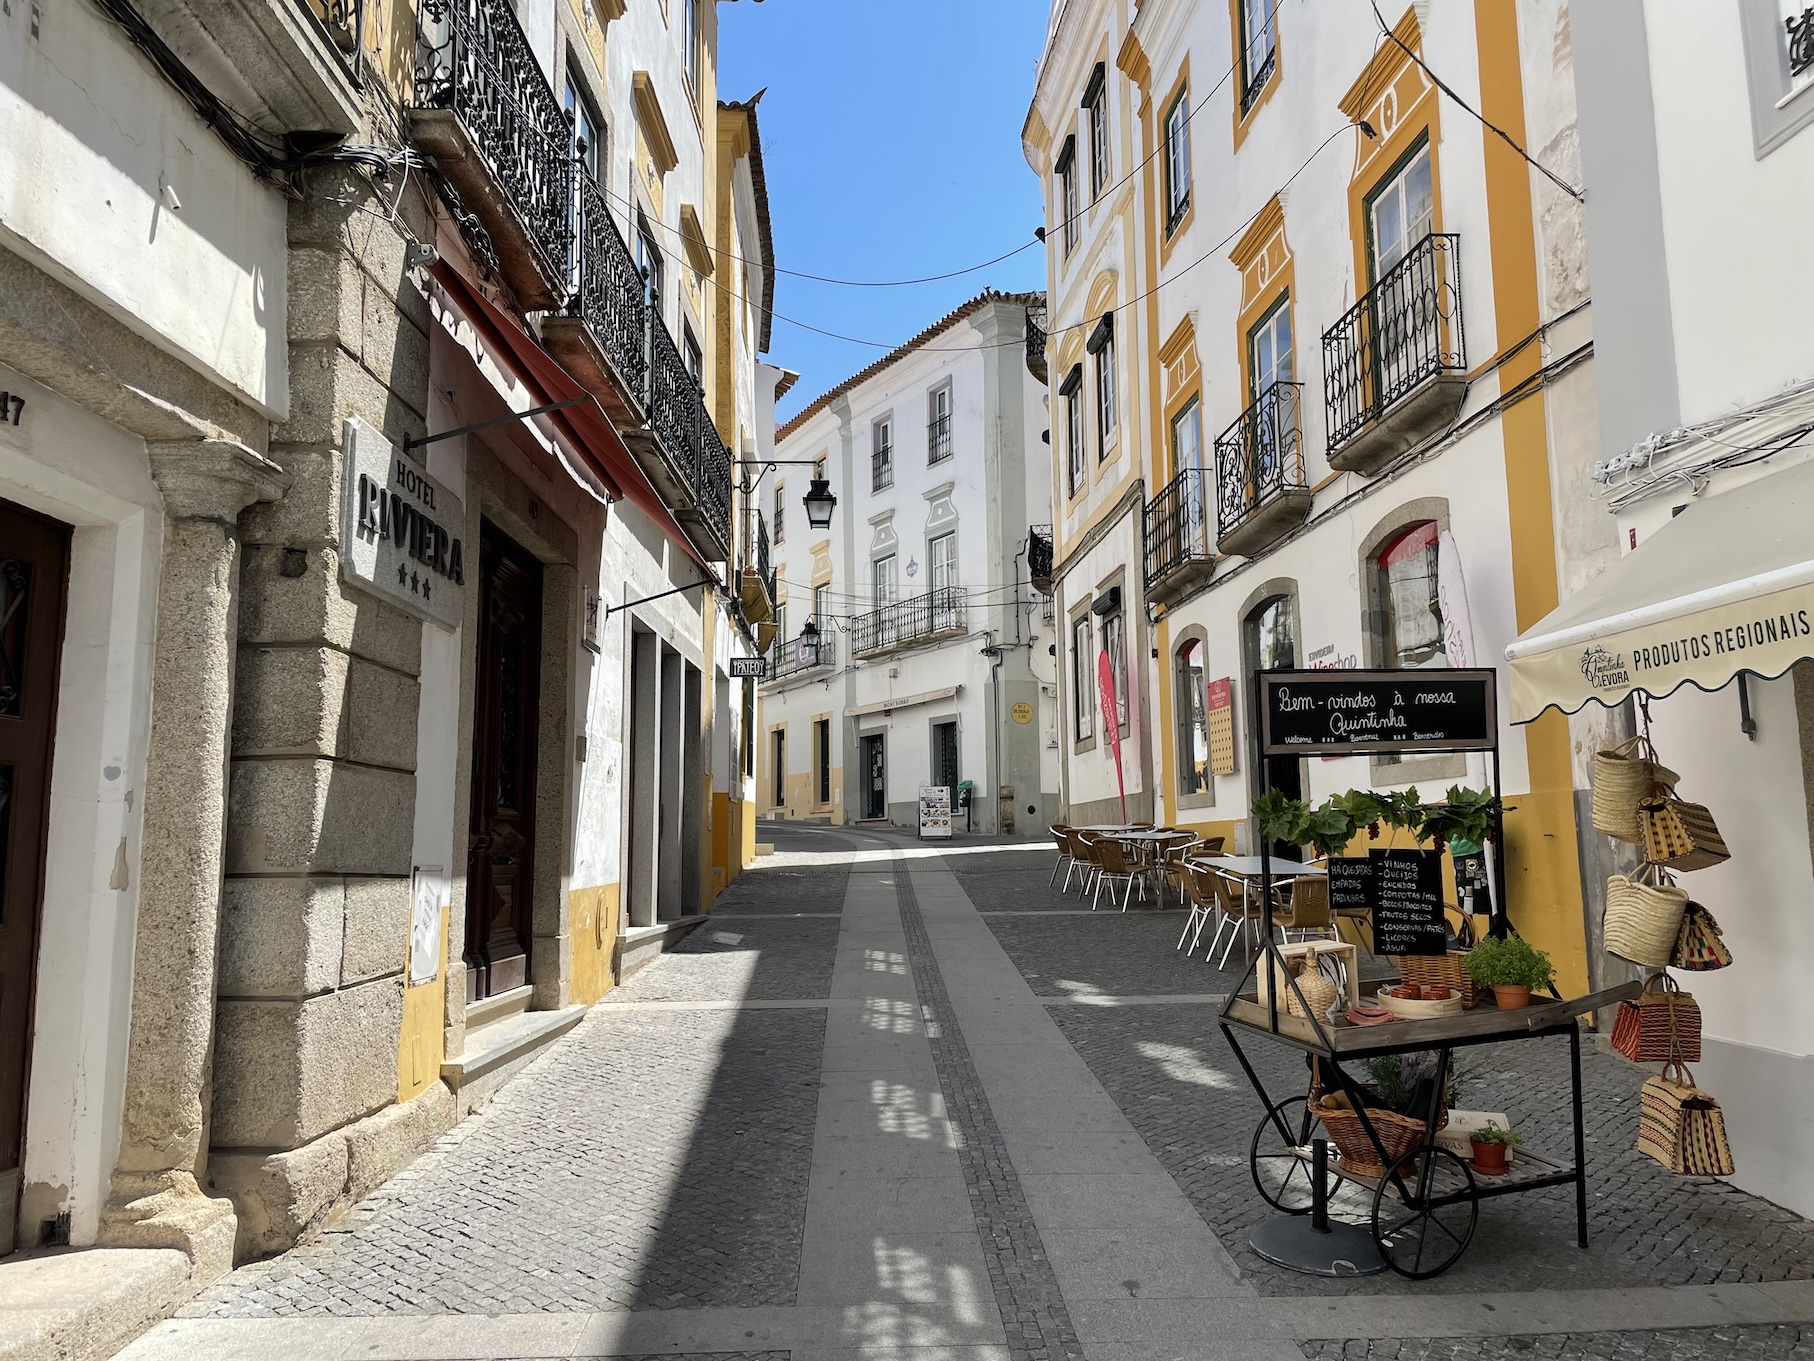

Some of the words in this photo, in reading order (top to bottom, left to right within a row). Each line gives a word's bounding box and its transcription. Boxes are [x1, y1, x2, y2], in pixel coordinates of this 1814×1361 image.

[396, 459, 437, 511] HOTEL
[358, 473, 465, 586] RIVIERA
[1633, 634, 1711, 671] PRODUTOS
[1714, 610, 1811, 654] REGIONAIS
[737, 660, 760, 675] PATEO
[1393, 691, 1405, 706] à
[1415, 692, 1457, 704] nossa
[1329, 708, 1408, 736] Quintinha
[1331, 879, 1362, 889] EMPADAS
[1410, 912, 1432, 921] SECOS
